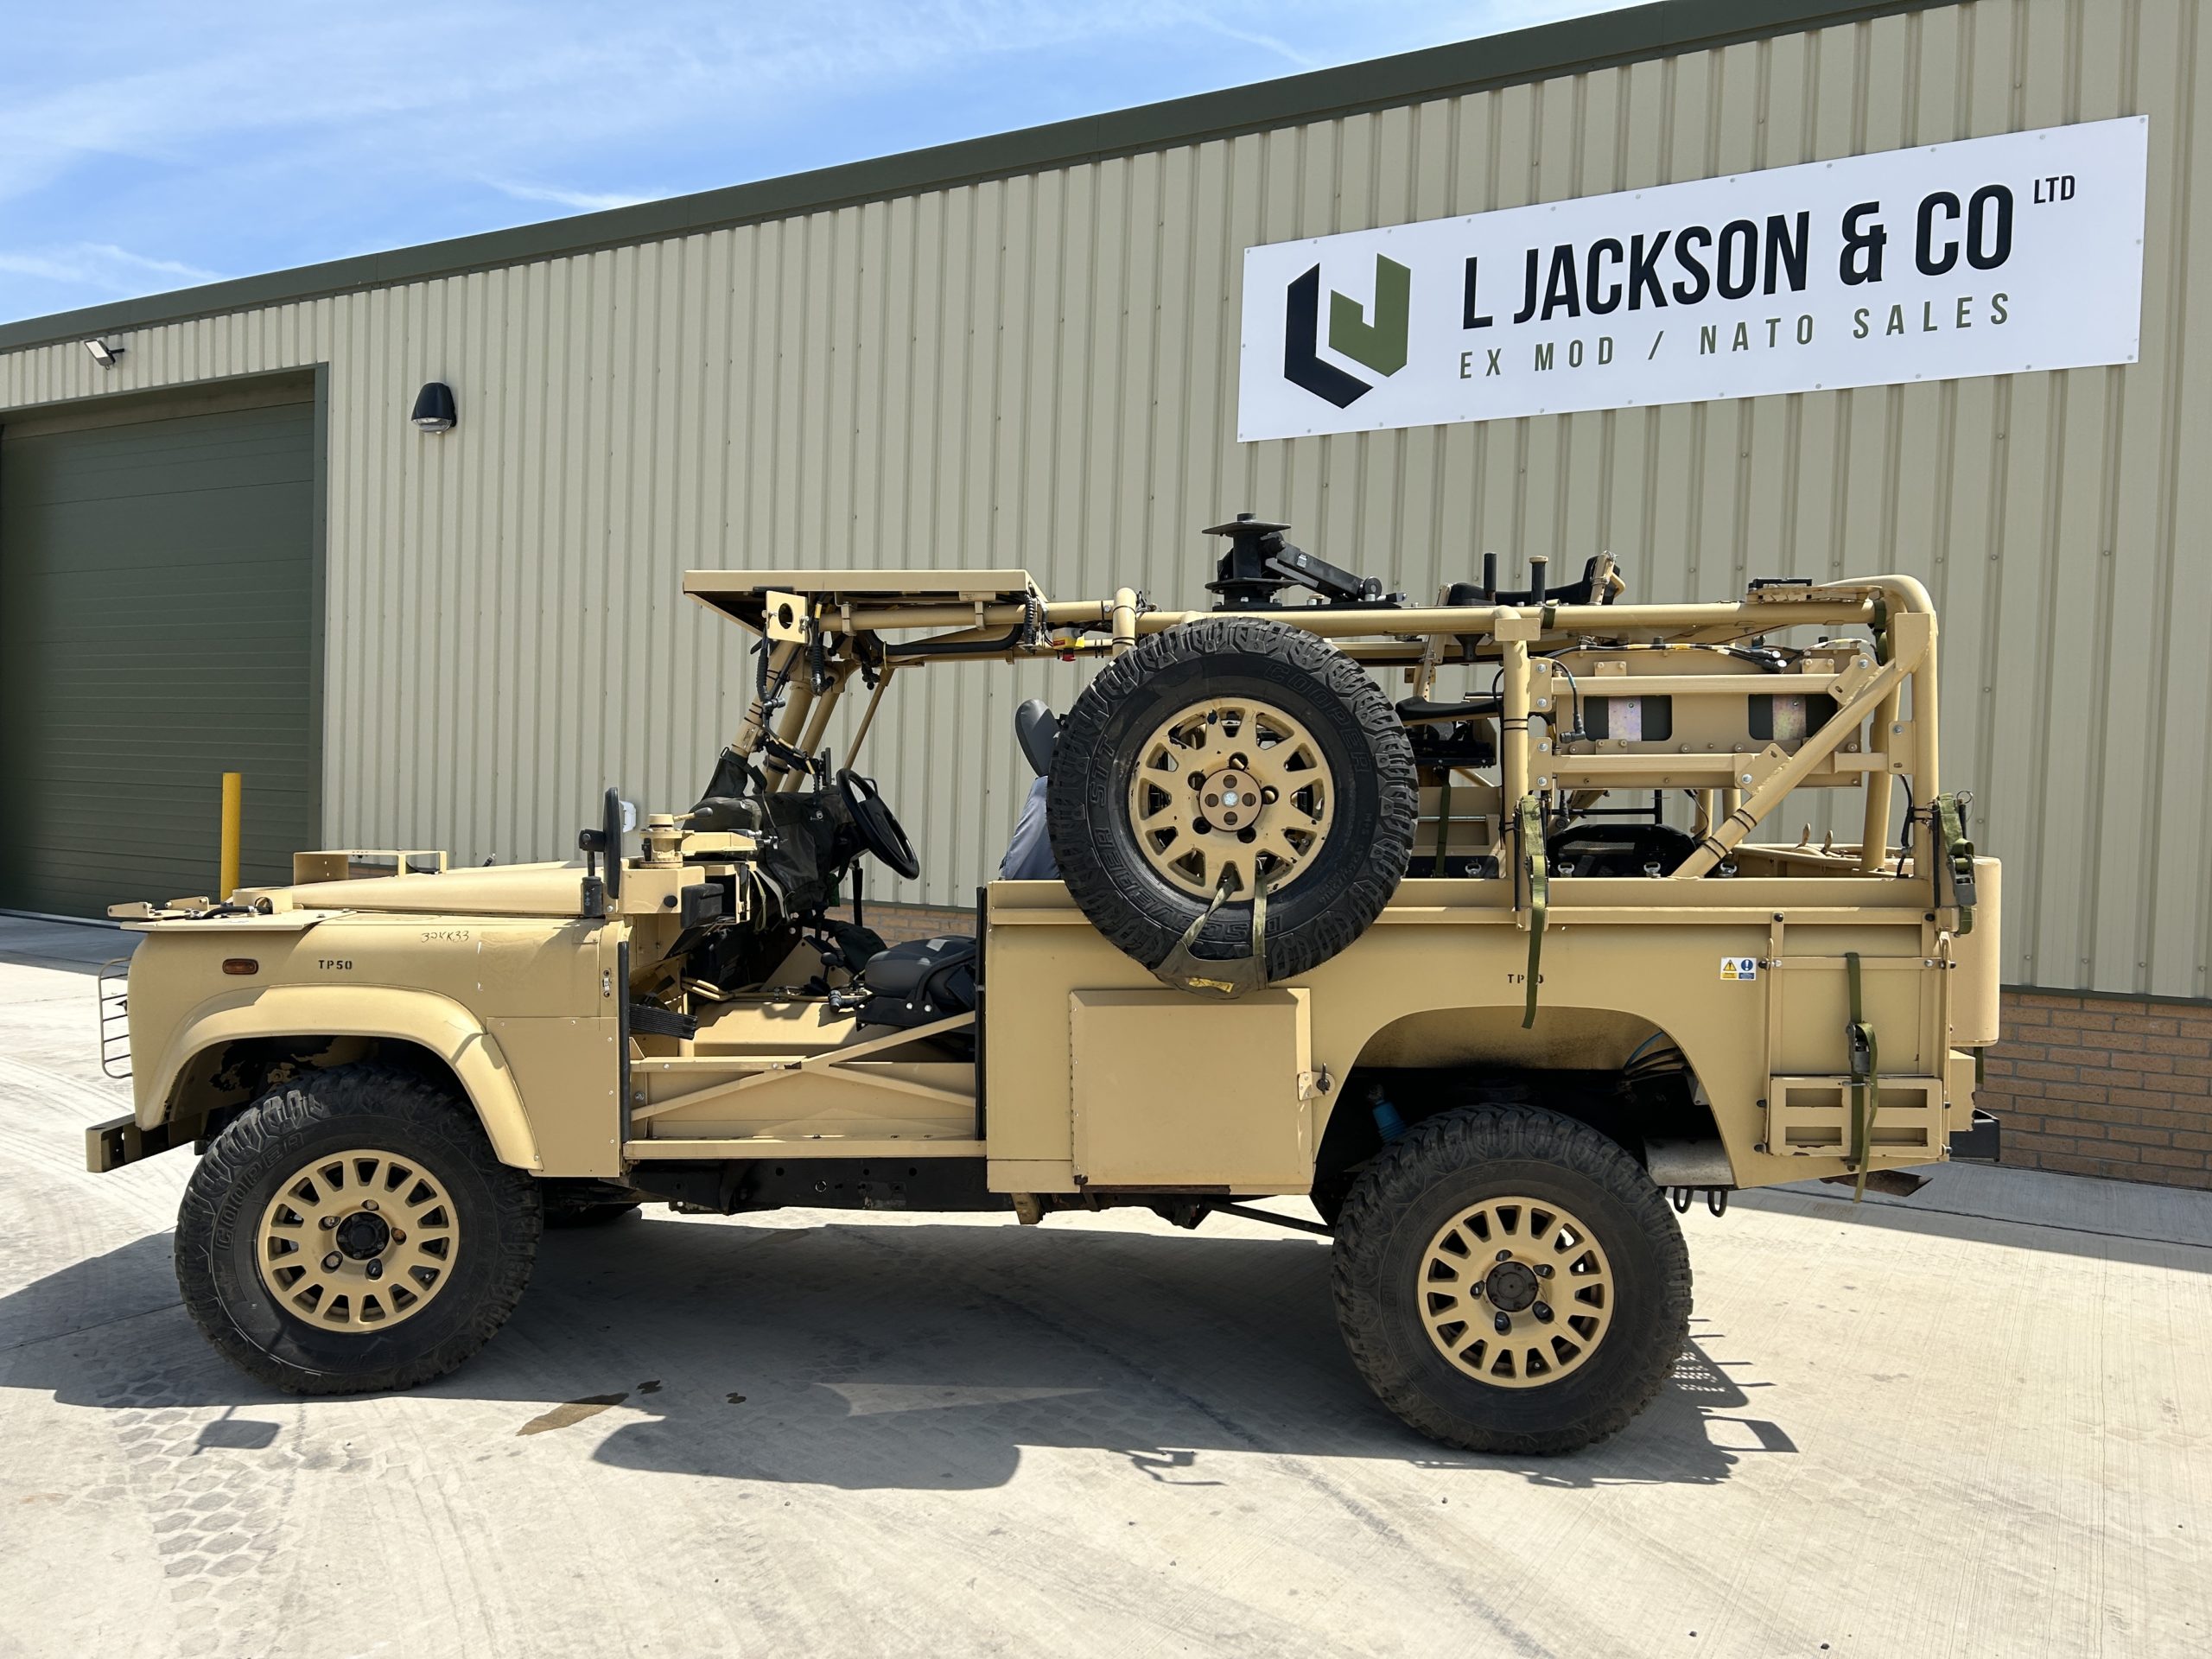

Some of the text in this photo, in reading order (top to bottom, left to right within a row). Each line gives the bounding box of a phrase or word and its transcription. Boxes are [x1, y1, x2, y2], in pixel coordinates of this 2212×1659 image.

[1463, 175, 2075, 329] L JACKSON & CO LTD
[1460, 347, 1502, 379] EX
[1534, 336, 1613, 372] MOD
[1700, 315, 1814, 355] NATO
[1853, 292, 2009, 340] SALES
[1264, 663, 1373, 772] COOPER
[1089, 734, 1116, 807] STT
[1094, 826, 1283, 940] DSCOVERER
[317, 959, 353, 970] TP50
[1507, 973, 1544, 984] TP0
[216, 1132, 305, 1250] COOPER
